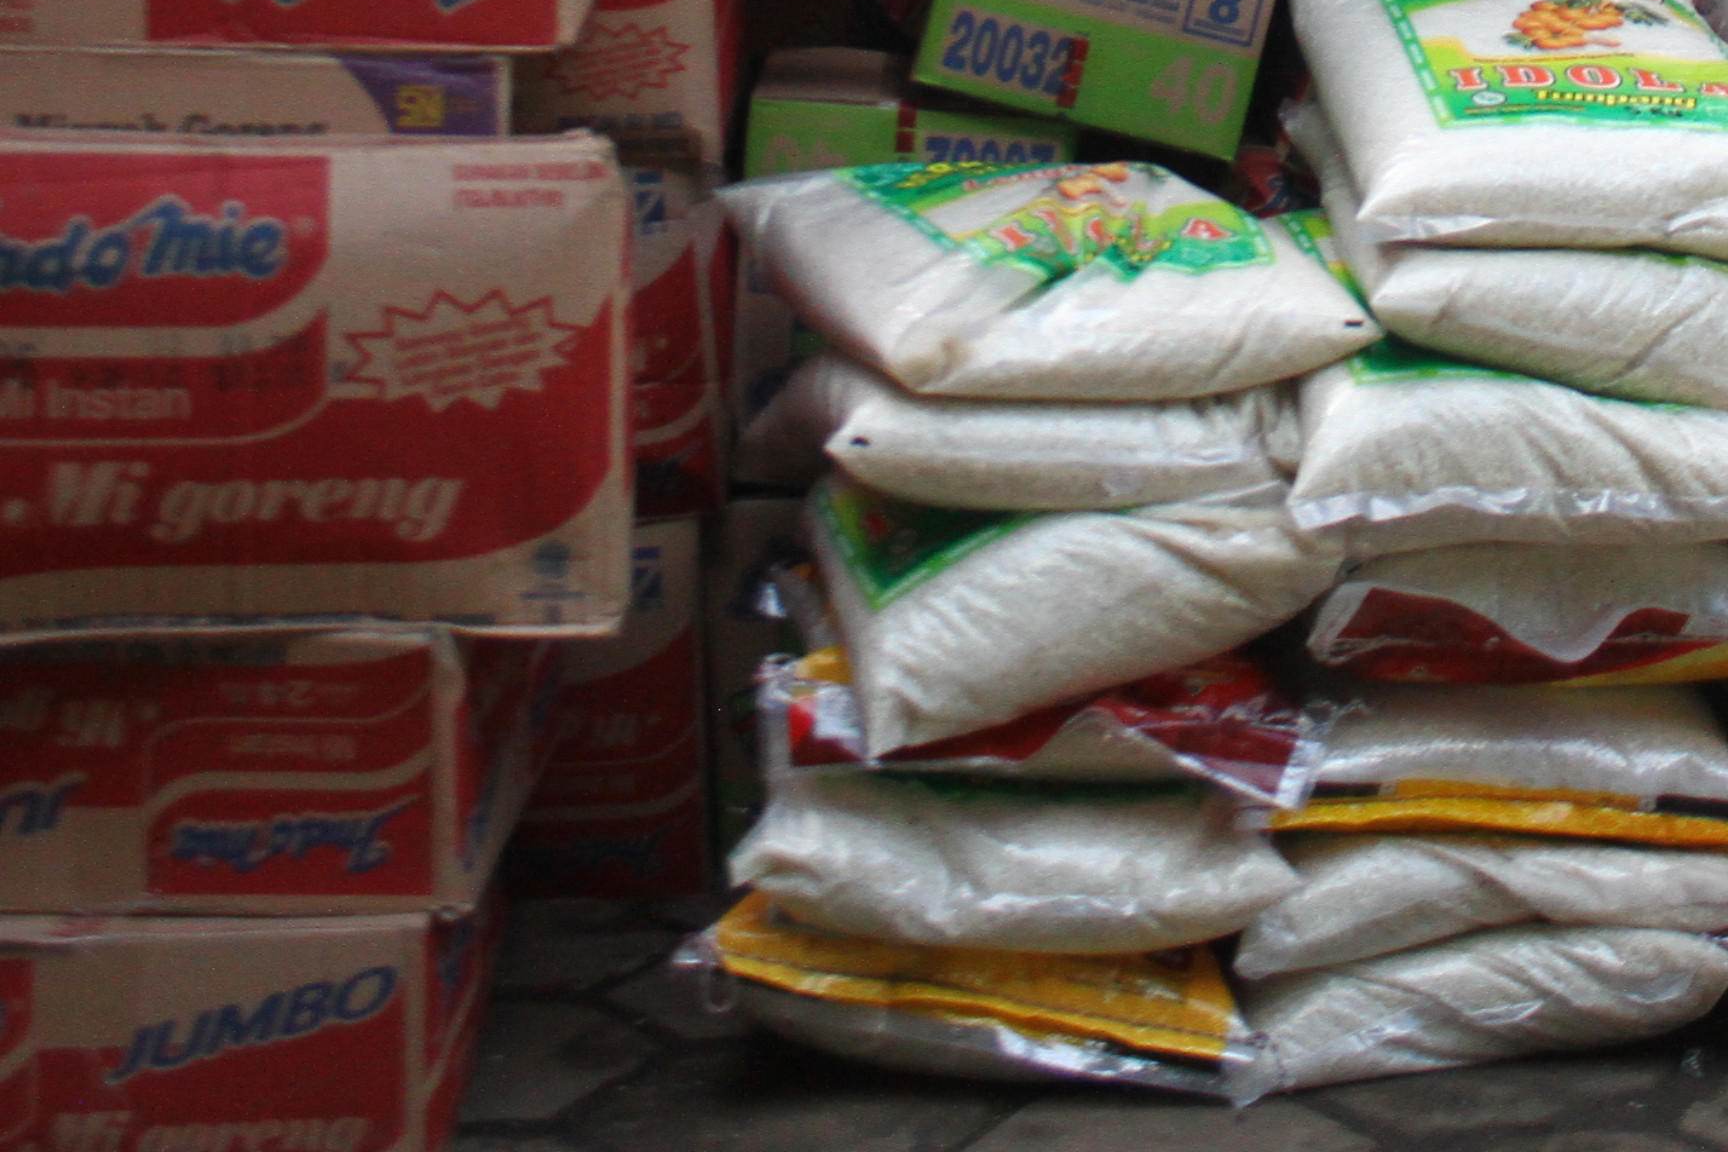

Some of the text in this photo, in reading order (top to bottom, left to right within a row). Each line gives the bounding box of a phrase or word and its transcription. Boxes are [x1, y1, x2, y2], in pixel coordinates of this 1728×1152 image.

[942, 10, 1076, 97] 20032
[1151, 55, 1238, 126] 40
[48, 380, 192, 420] Instan
[47, 461, 466, 542] Mi goreng
[104, 965, 398, 1086] JUMBO
